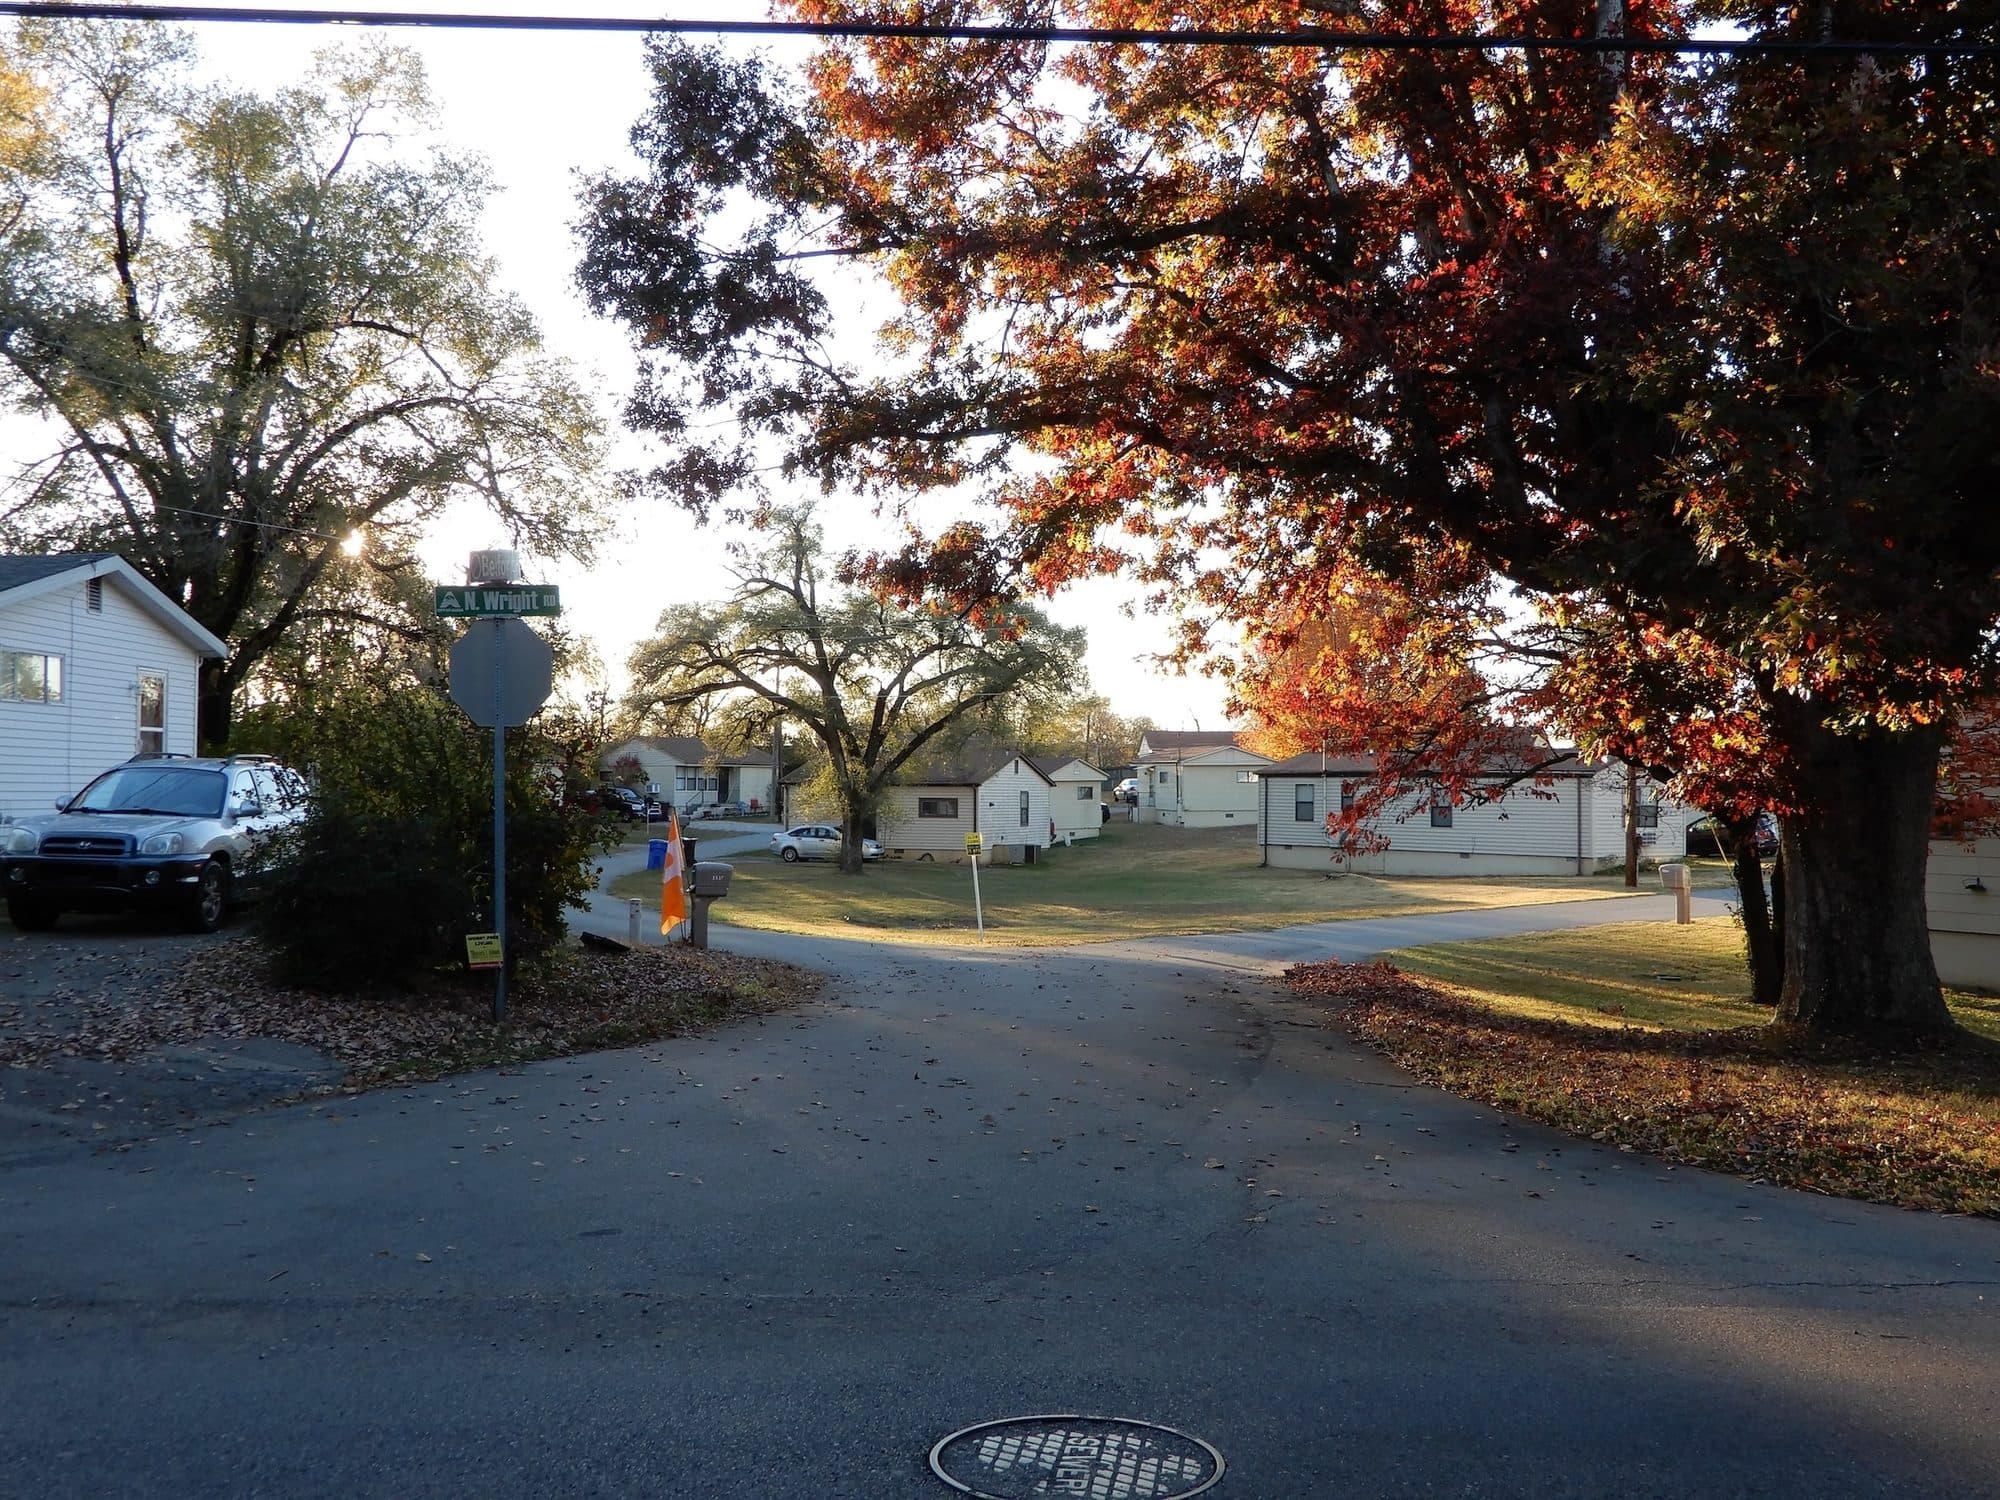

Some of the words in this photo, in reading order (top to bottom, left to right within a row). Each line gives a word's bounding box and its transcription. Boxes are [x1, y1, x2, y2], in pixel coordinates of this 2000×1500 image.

[464, 591, 479, 611] N.
[482, 590, 539, 612] Wright
[543, 594, 556, 607] RD
[1054, 1437, 1101, 1490] SEWER
